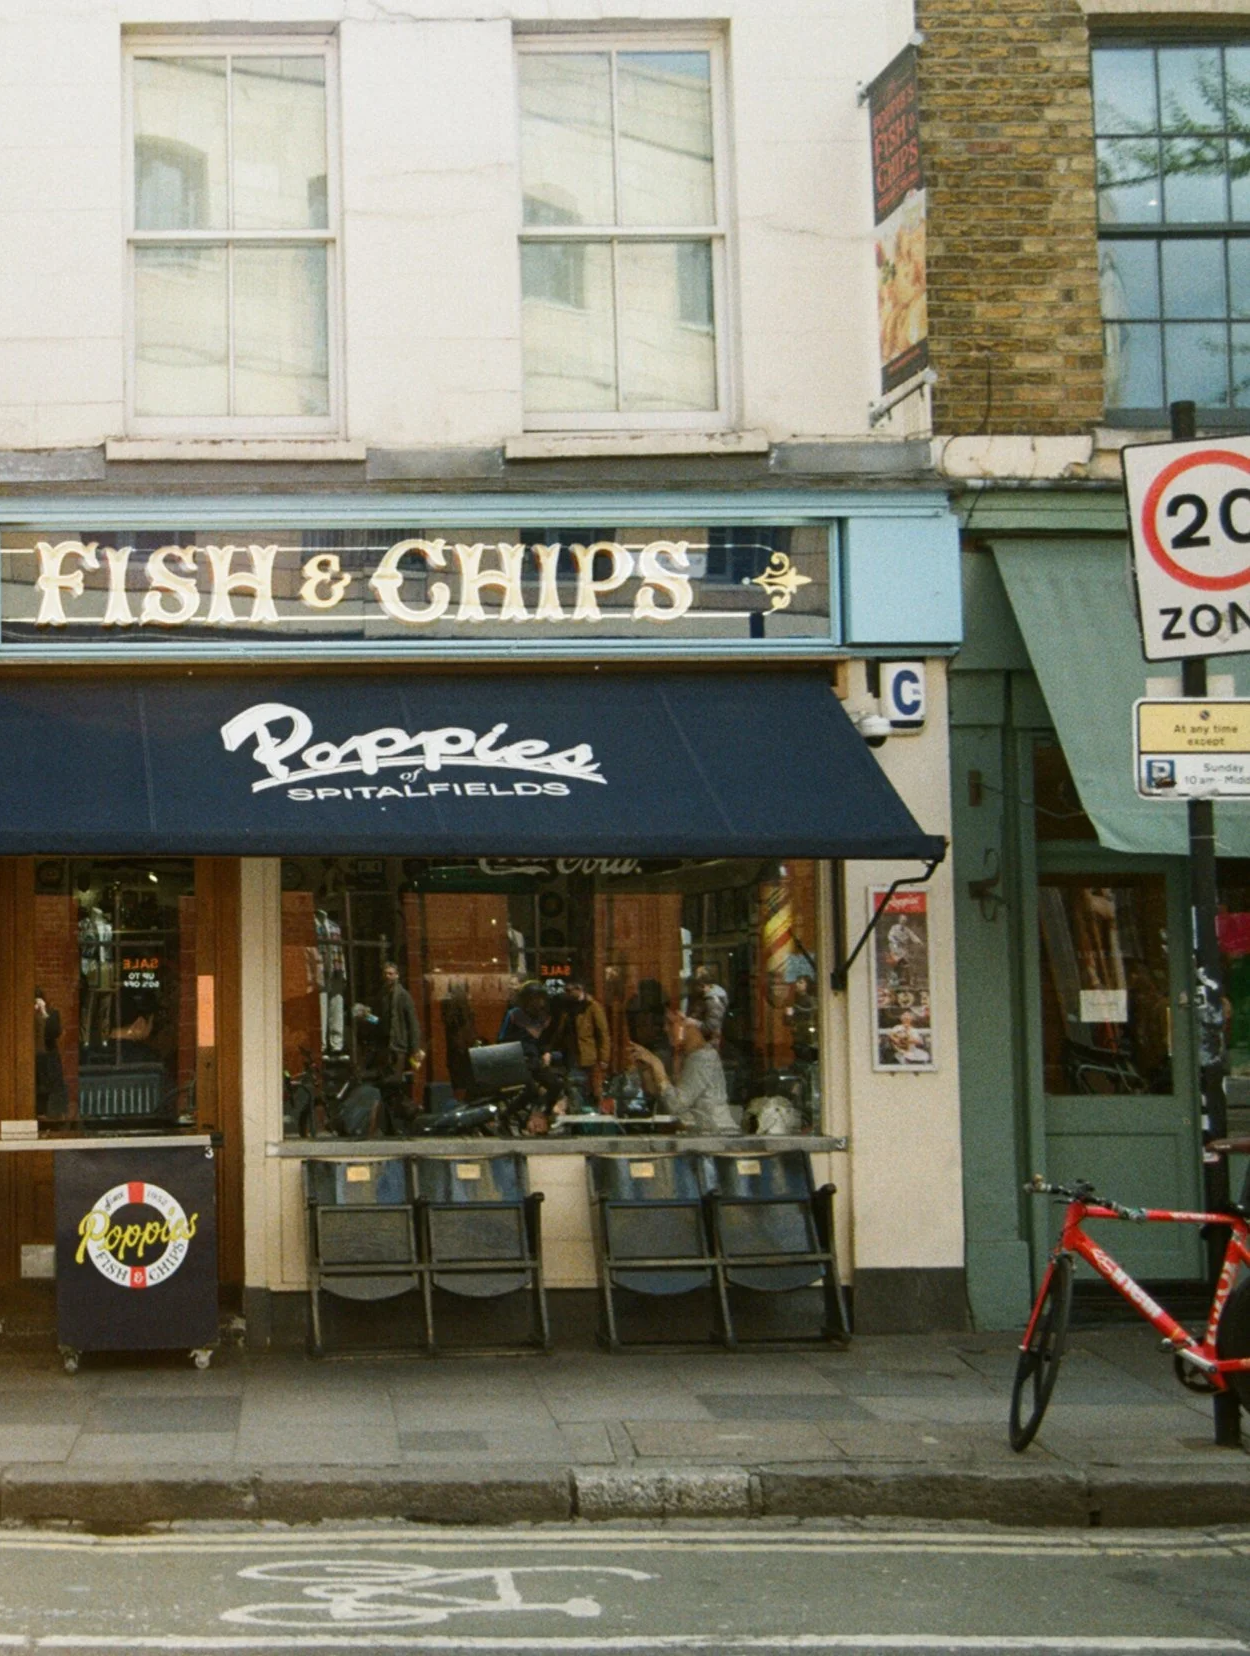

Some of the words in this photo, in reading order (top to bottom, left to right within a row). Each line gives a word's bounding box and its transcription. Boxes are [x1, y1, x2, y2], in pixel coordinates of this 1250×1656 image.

[875, 113, 907, 166] FISH
[877, 136, 918, 193] CHIPS
[1166, 488, 1250, 549] 20
[35, 541, 279, 627] FISH
[300, 554, 351, 609] &
[370, 538, 694, 626] CHIPS
[892, 670, 921, 716] C
[221, 703, 604, 783] Poppies
[1174, 724, 1187, 733] At
[1190, 726, 1210, 735] any
[1213, 724, 1238, 733] time
[1187, 738, 1225, 746] except
[400, 768, 423, 783] of
[1184, 775, 1197, 784] 10
[1203, 763, 1244, 773] Sunday
[287, 782, 571, 801] SPITALFIELDS
[205, 1146, 214, 1159] 3
[75, 1206, 199, 1265] Poppies
[95, 1251, 129, 1281] FISH
[133, 1271, 144, 1284] &
[148, 1242, 185, 1281] CHIPS
